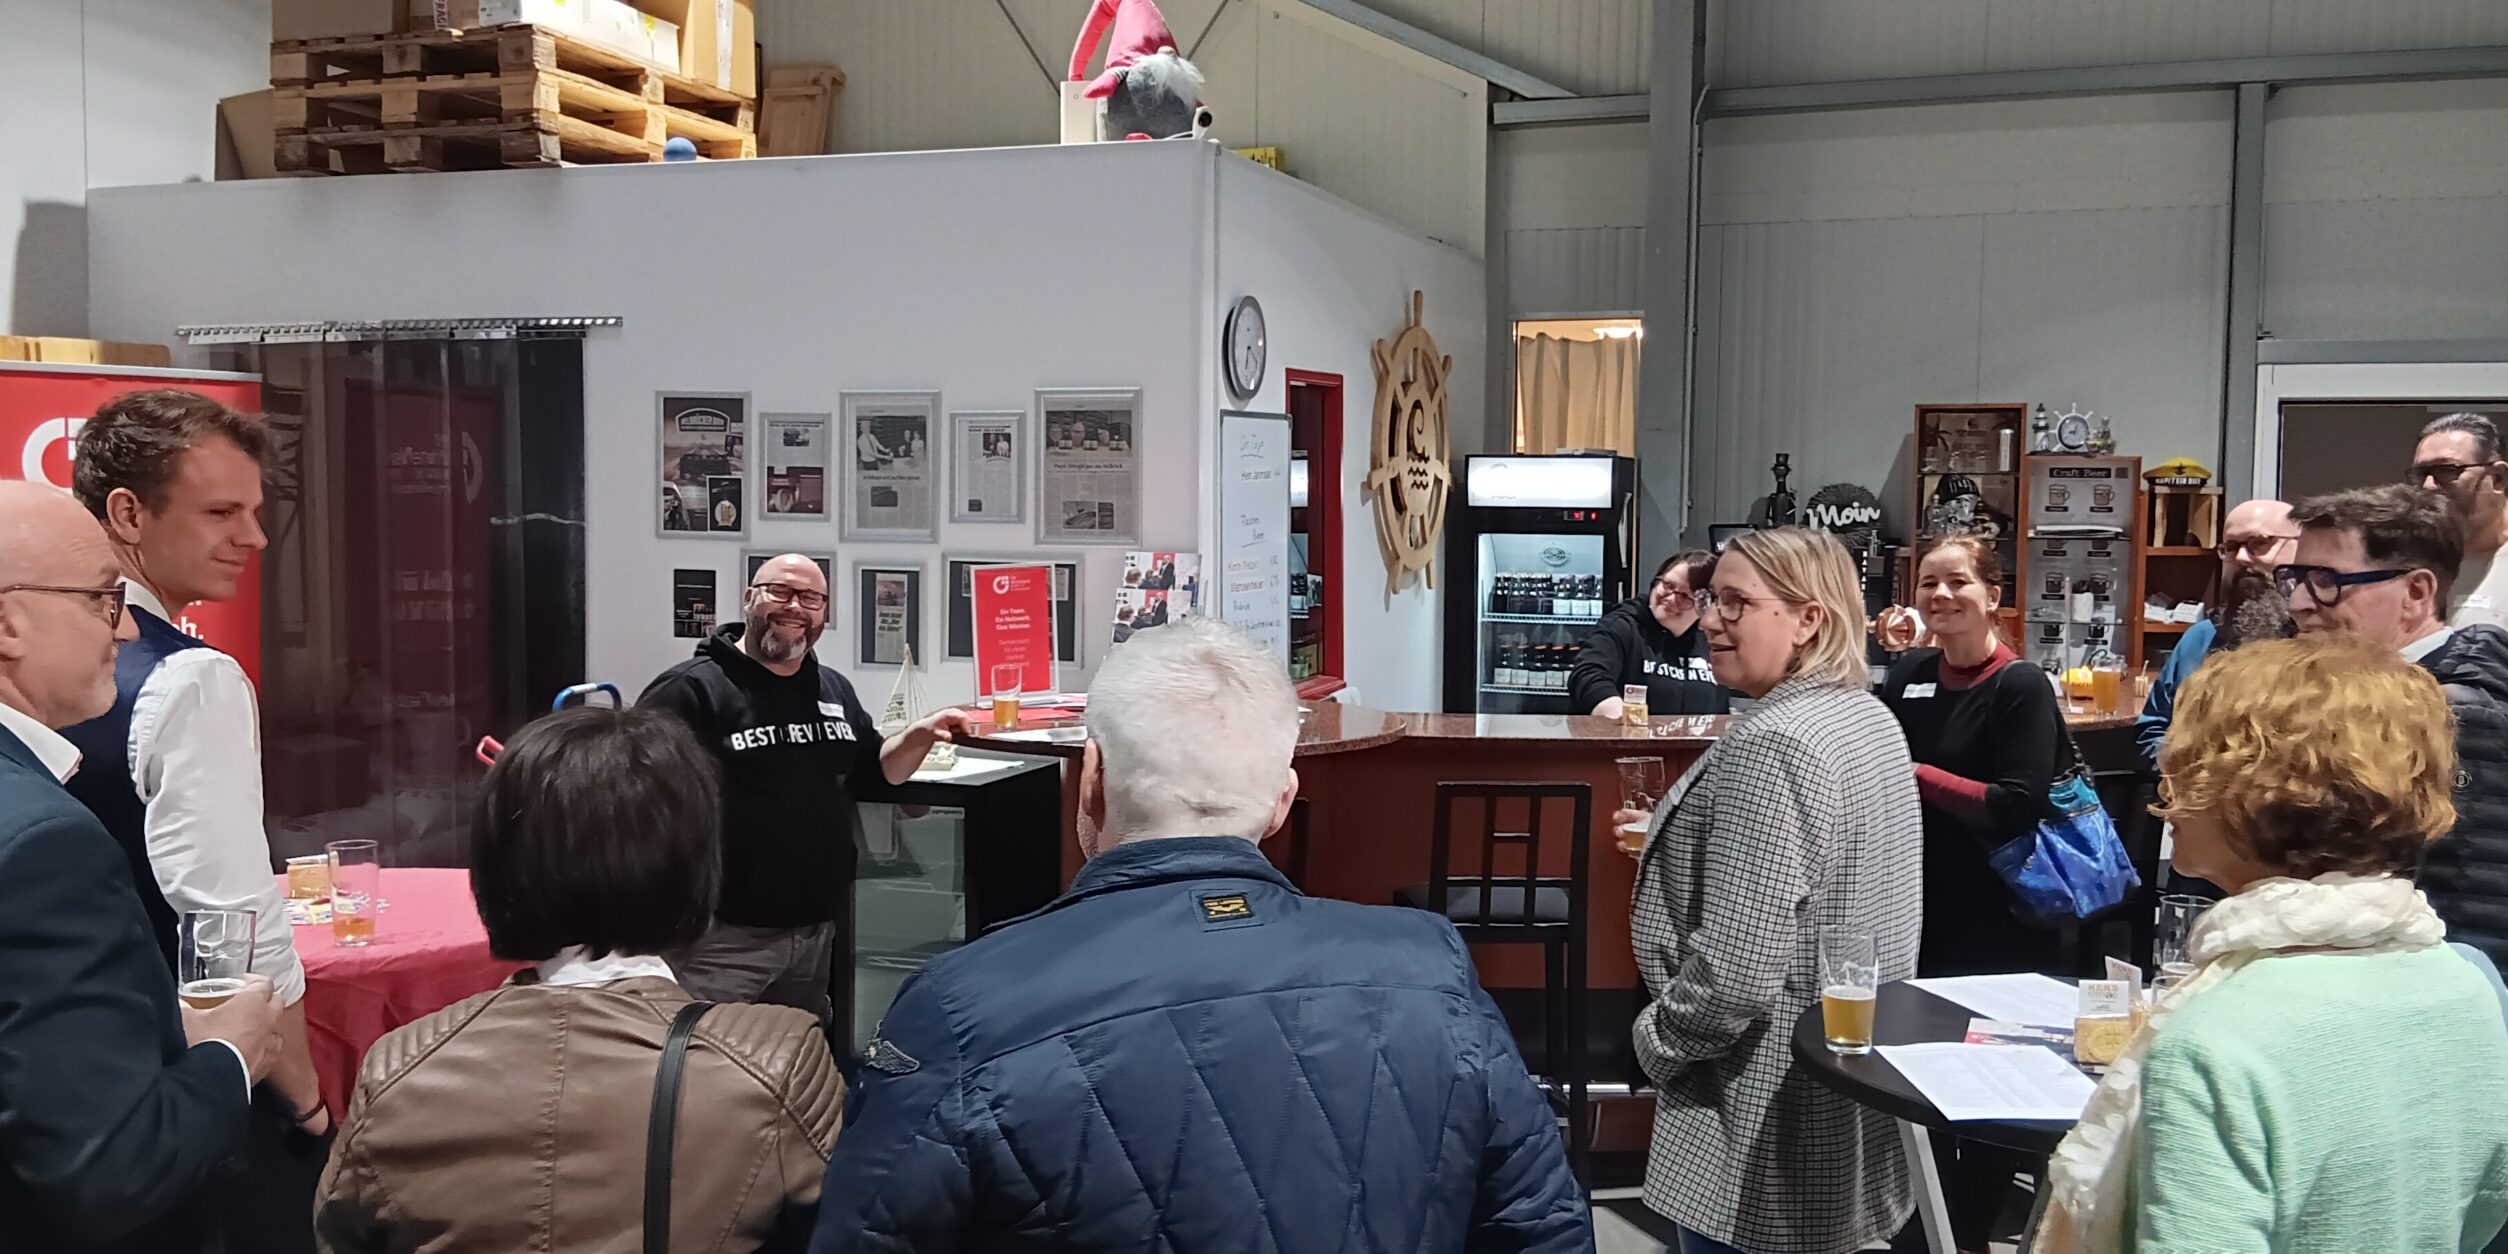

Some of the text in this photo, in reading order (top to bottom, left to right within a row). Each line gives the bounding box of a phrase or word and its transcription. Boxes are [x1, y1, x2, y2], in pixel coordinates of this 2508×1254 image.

[2053, 469, 2107, 478] Craft Beer
[1806, 501, 1880, 534] Moin
[731, 725, 777, 751] BEST
[824, 721, 858, 743] EVER
